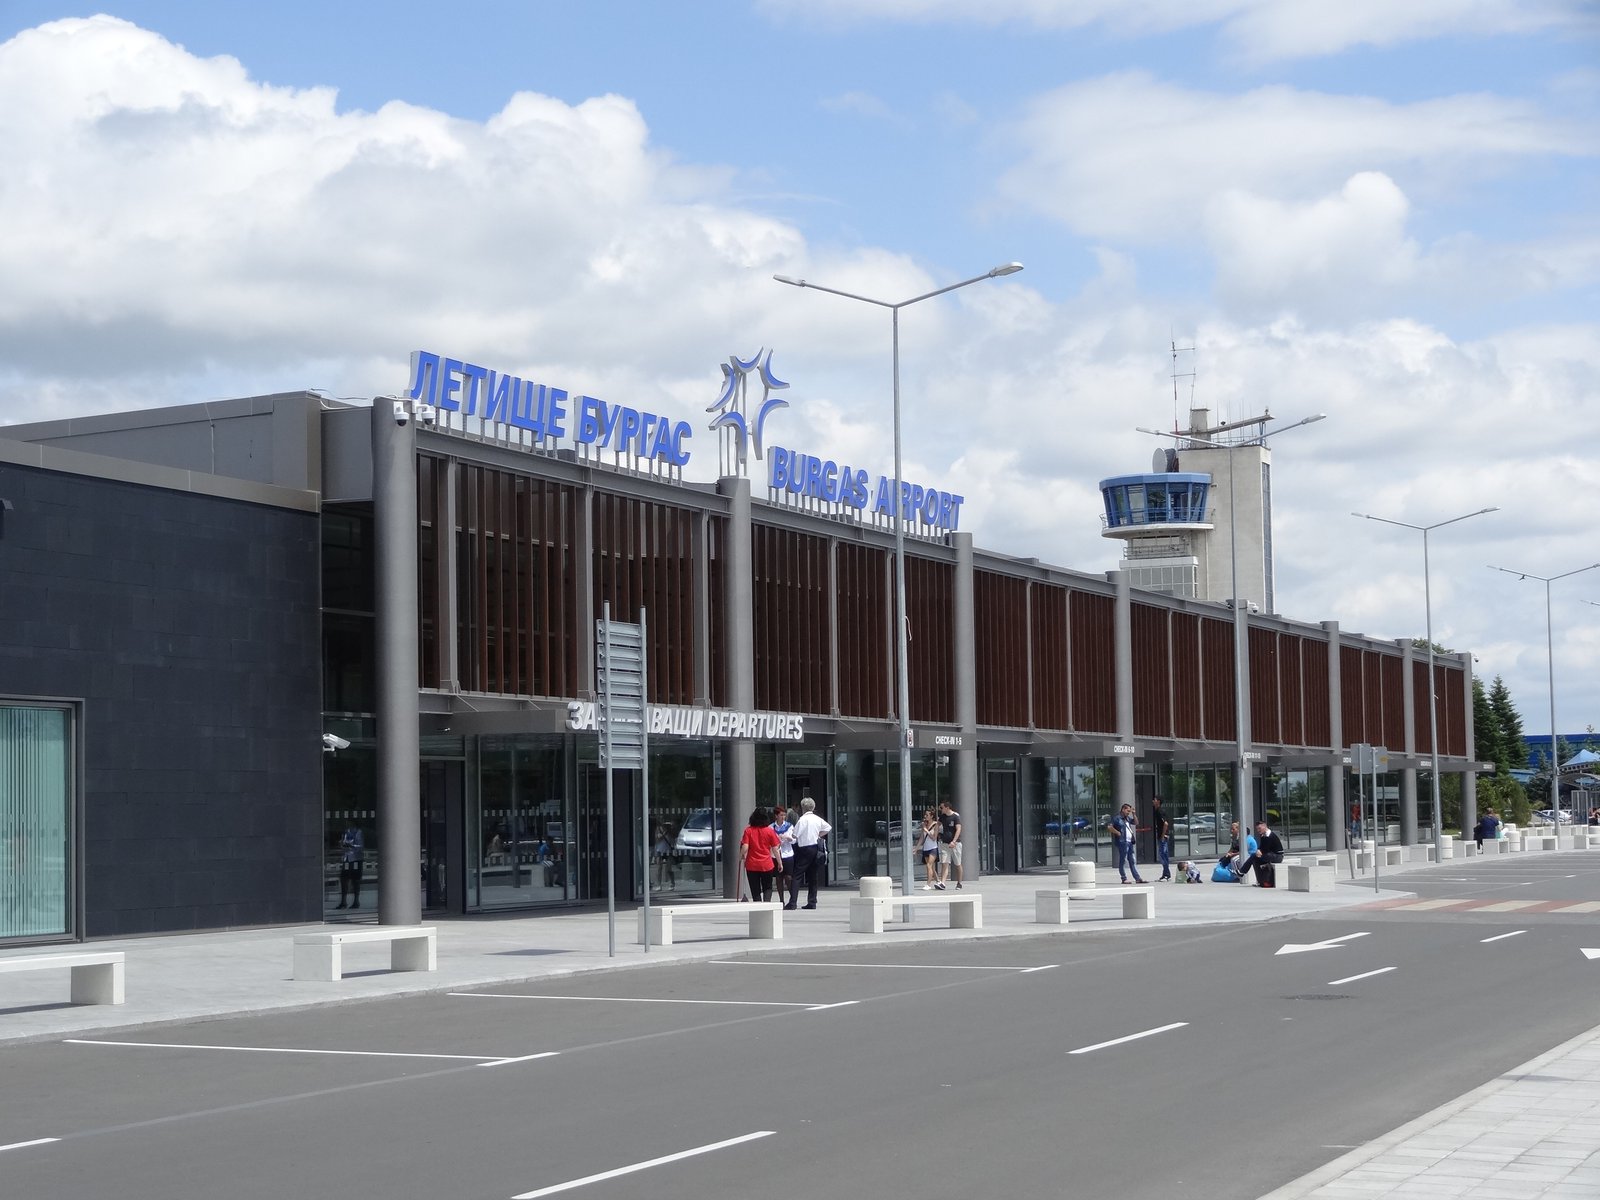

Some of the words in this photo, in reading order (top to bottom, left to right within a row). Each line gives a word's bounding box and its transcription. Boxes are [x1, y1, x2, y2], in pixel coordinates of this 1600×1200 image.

[404, 350, 569, 443] ЛЕТИЩЕ
[573, 395, 692, 466] БУРГАС
[767, 445, 869, 510] BURGAS
[870, 475, 965, 531] AIRPORT
[706, 711, 804, 740] DEPARTURES
[935, 735, 955, 745] CHECK-IN
